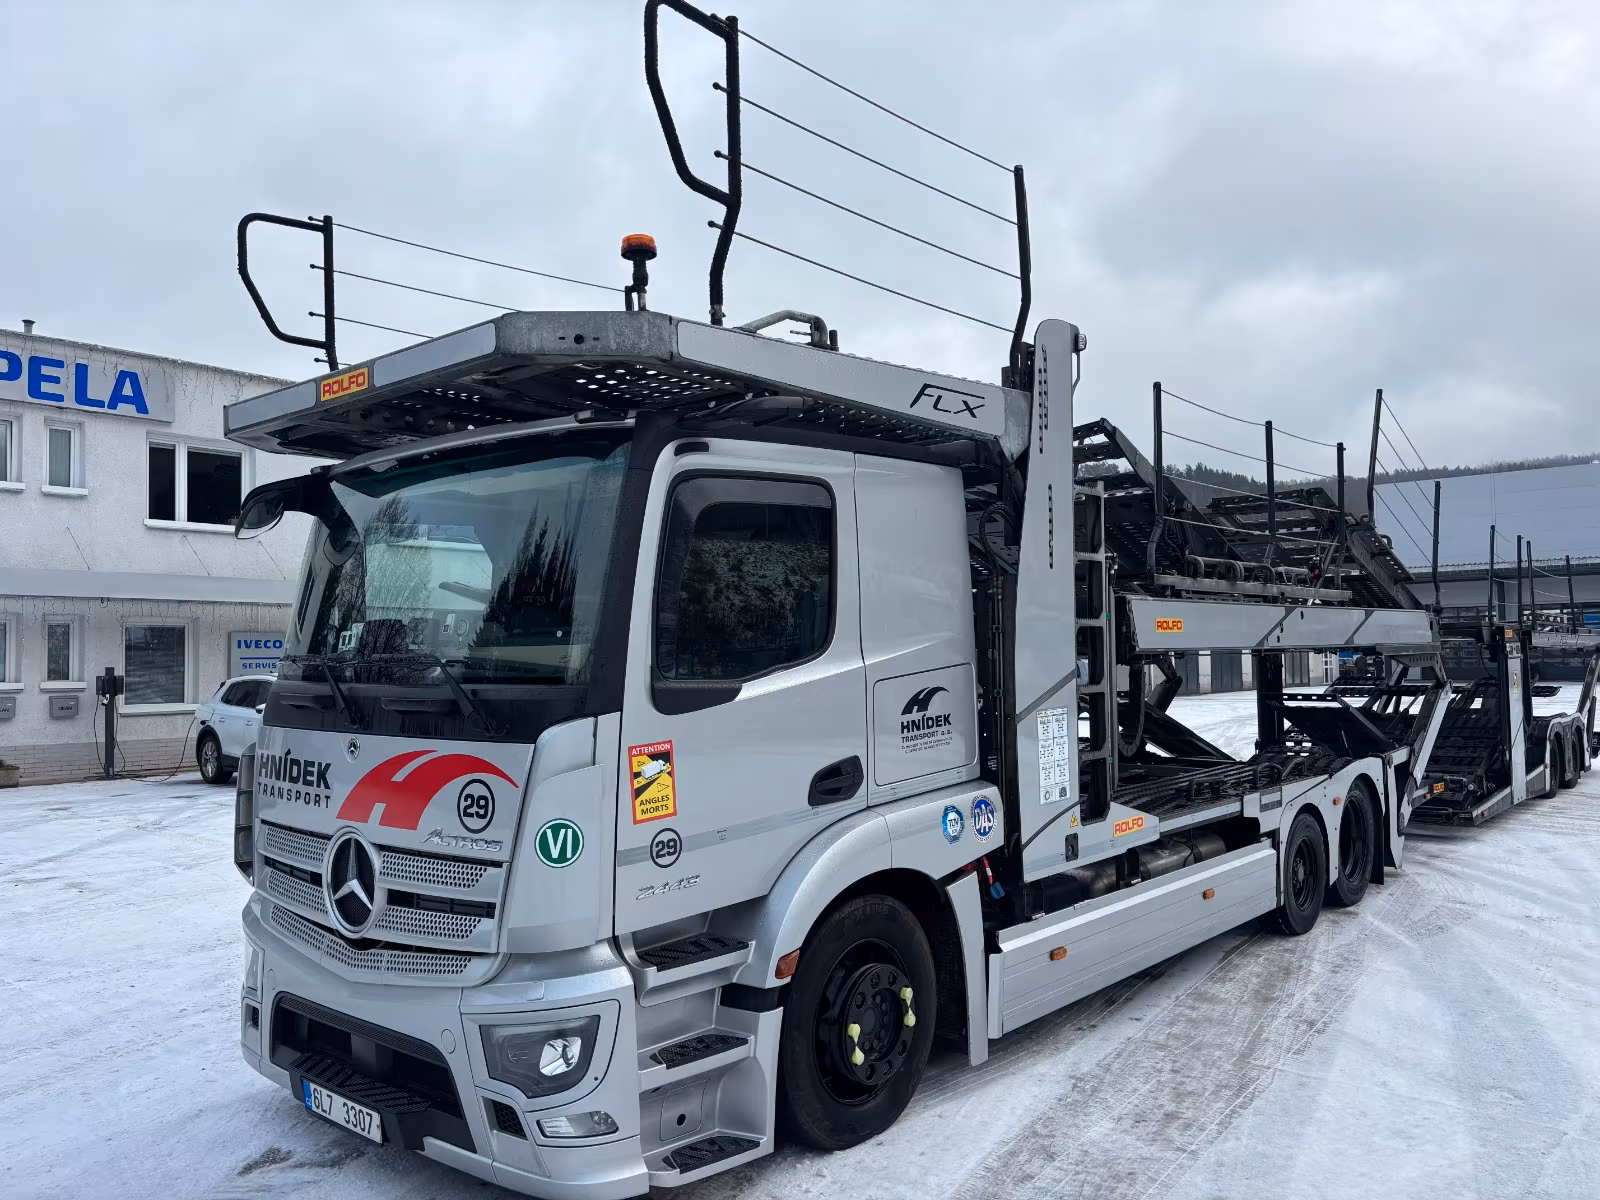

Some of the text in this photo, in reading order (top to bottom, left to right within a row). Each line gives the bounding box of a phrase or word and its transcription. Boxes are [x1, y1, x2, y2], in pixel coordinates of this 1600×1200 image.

[323, 372, 365, 398] ROLFO
[1157, 620, 1182, 631] ROLFO
[237, 639, 283, 649] IVECO
[242, 662, 277, 670] SERVIS
[901, 713, 952, 734] HNÍDEK
[902, 731, 939, 743] TRANSPORT
[631, 743, 671, 756] ATTENTION
[259, 748, 332, 790] HNÍDEK
[257, 782, 331, 809] TRANSPORT
[463, 793, 490, 819] 29
[639, 794, 670, 807] ANGLES
[641, 804, 669, 816] MORTS
[975, 804, 994, 833] DAS
[1115, 816, 1144, 835] ROLFO
[546, 828, 573, 859] VI
[655, 838, 678, 859] 29
[313, 1087, 373, 1135] 6L7 3307
